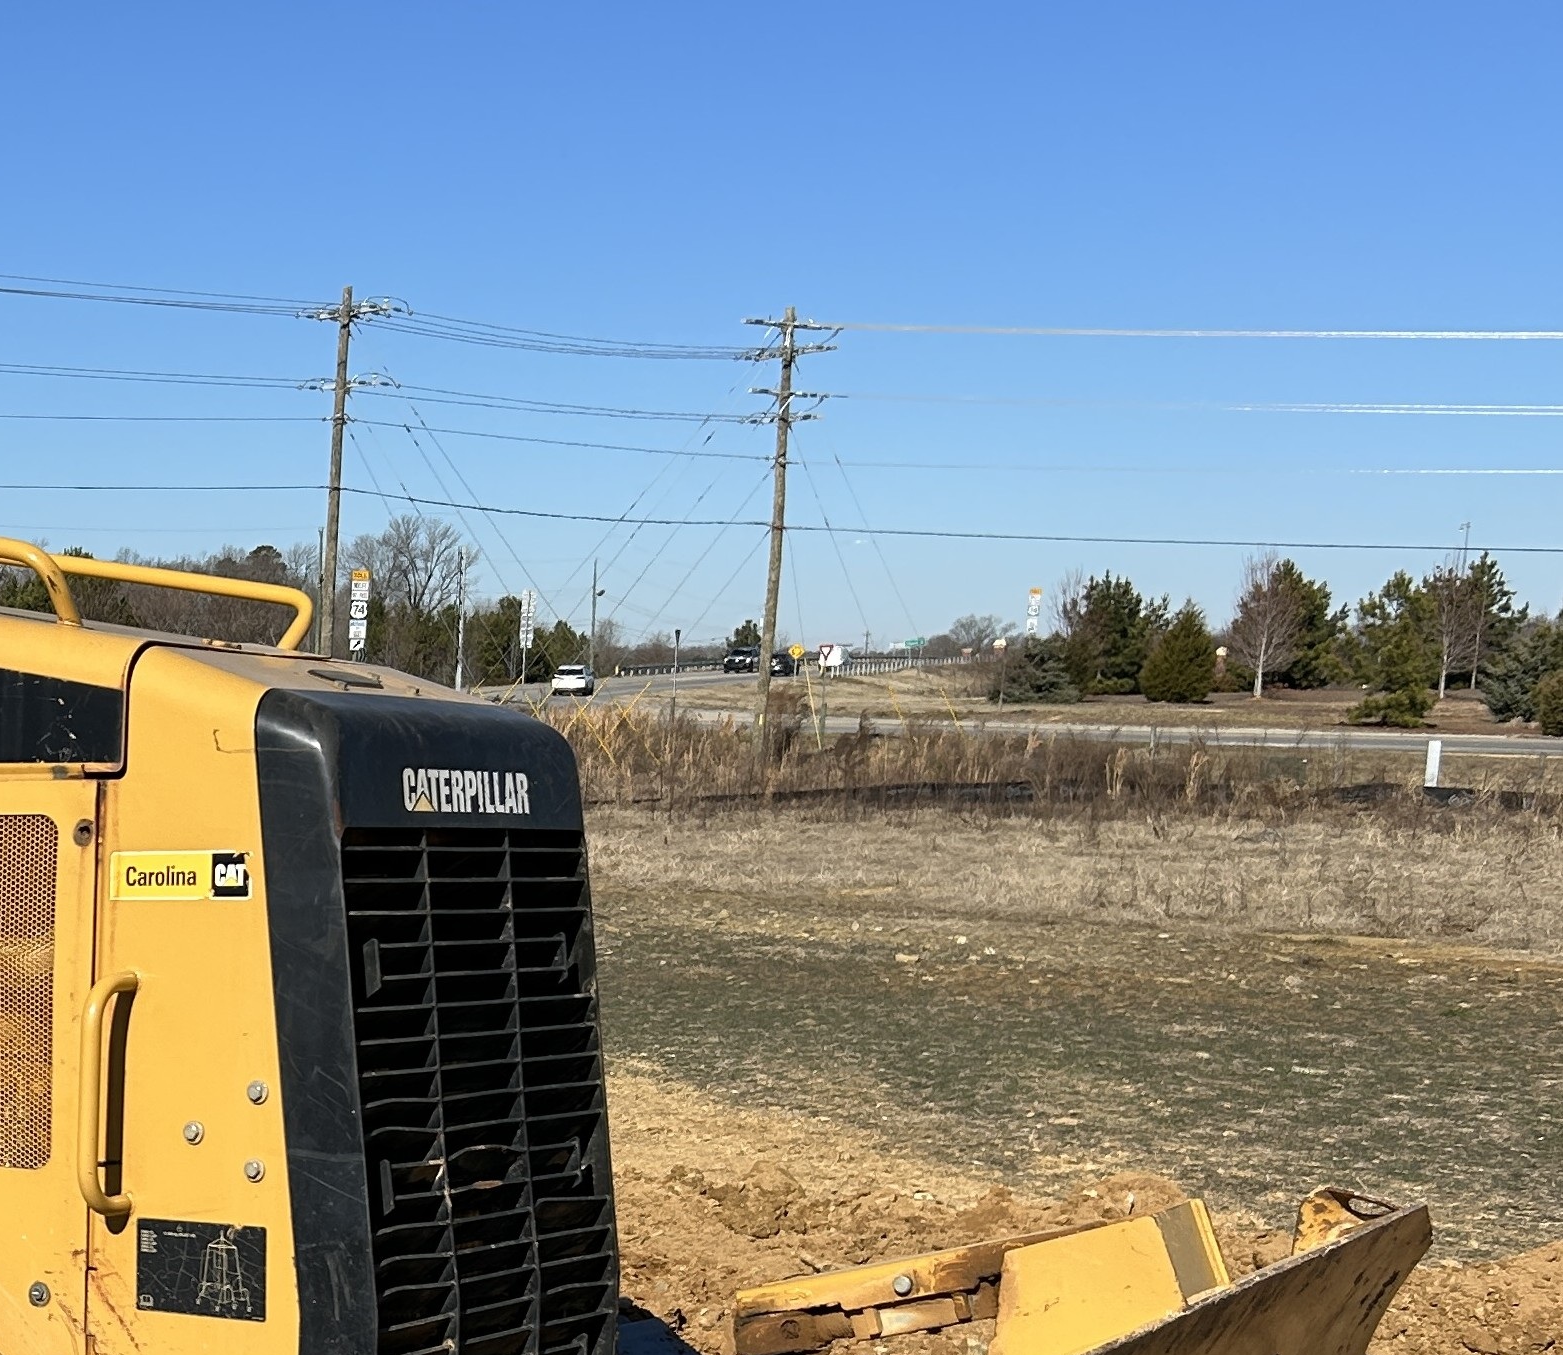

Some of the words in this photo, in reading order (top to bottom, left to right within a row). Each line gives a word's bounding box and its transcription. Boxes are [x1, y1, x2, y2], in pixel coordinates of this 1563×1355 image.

[352, 604, 365, 616] 74
[402, 767, 530, 815] CATERPILLAR
[125, 865, 197, 887] Carolina
[214, 862, 246, 887] CAT
